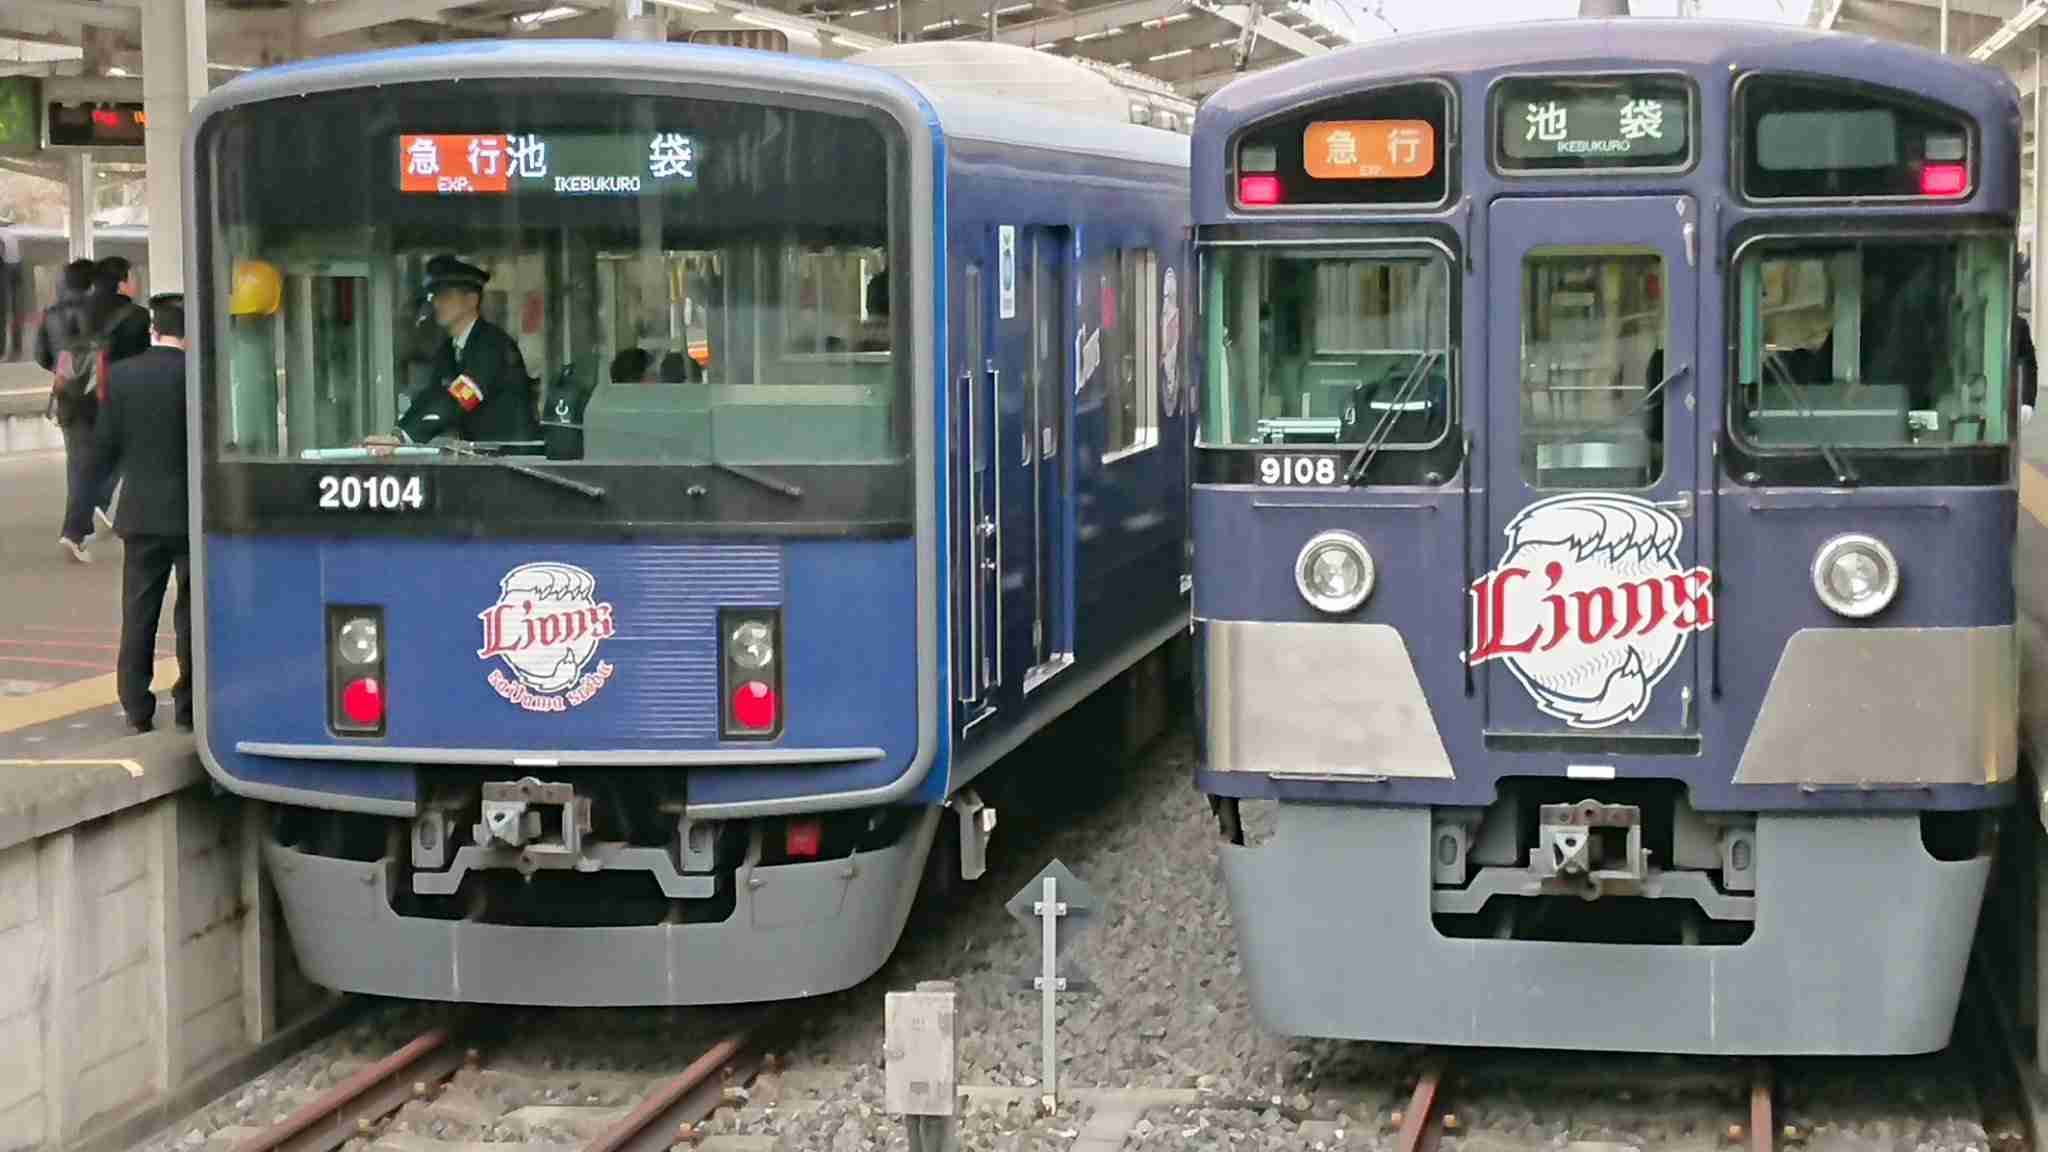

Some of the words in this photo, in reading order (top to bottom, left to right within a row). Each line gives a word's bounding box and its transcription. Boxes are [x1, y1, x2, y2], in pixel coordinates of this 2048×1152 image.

[1525, 99, 1663, 142] 池袋
[407, 138, 499, 175] 急行
[505, 134, 693, 178] 池袋
[1325, 128, 1421, 166] 急行
[1557, 140, 1630, 153] IKEBUKURO
[437, 176, 475, 192] EXP.
[554, 176, 640, 192] IKEBUKURO
[1260, 457, 1335, 484] 9108
[319, 476, 423, 508] 20104
[479, 600, 614, 658] Lions
[1466, 561, 1713, 664] Lions
